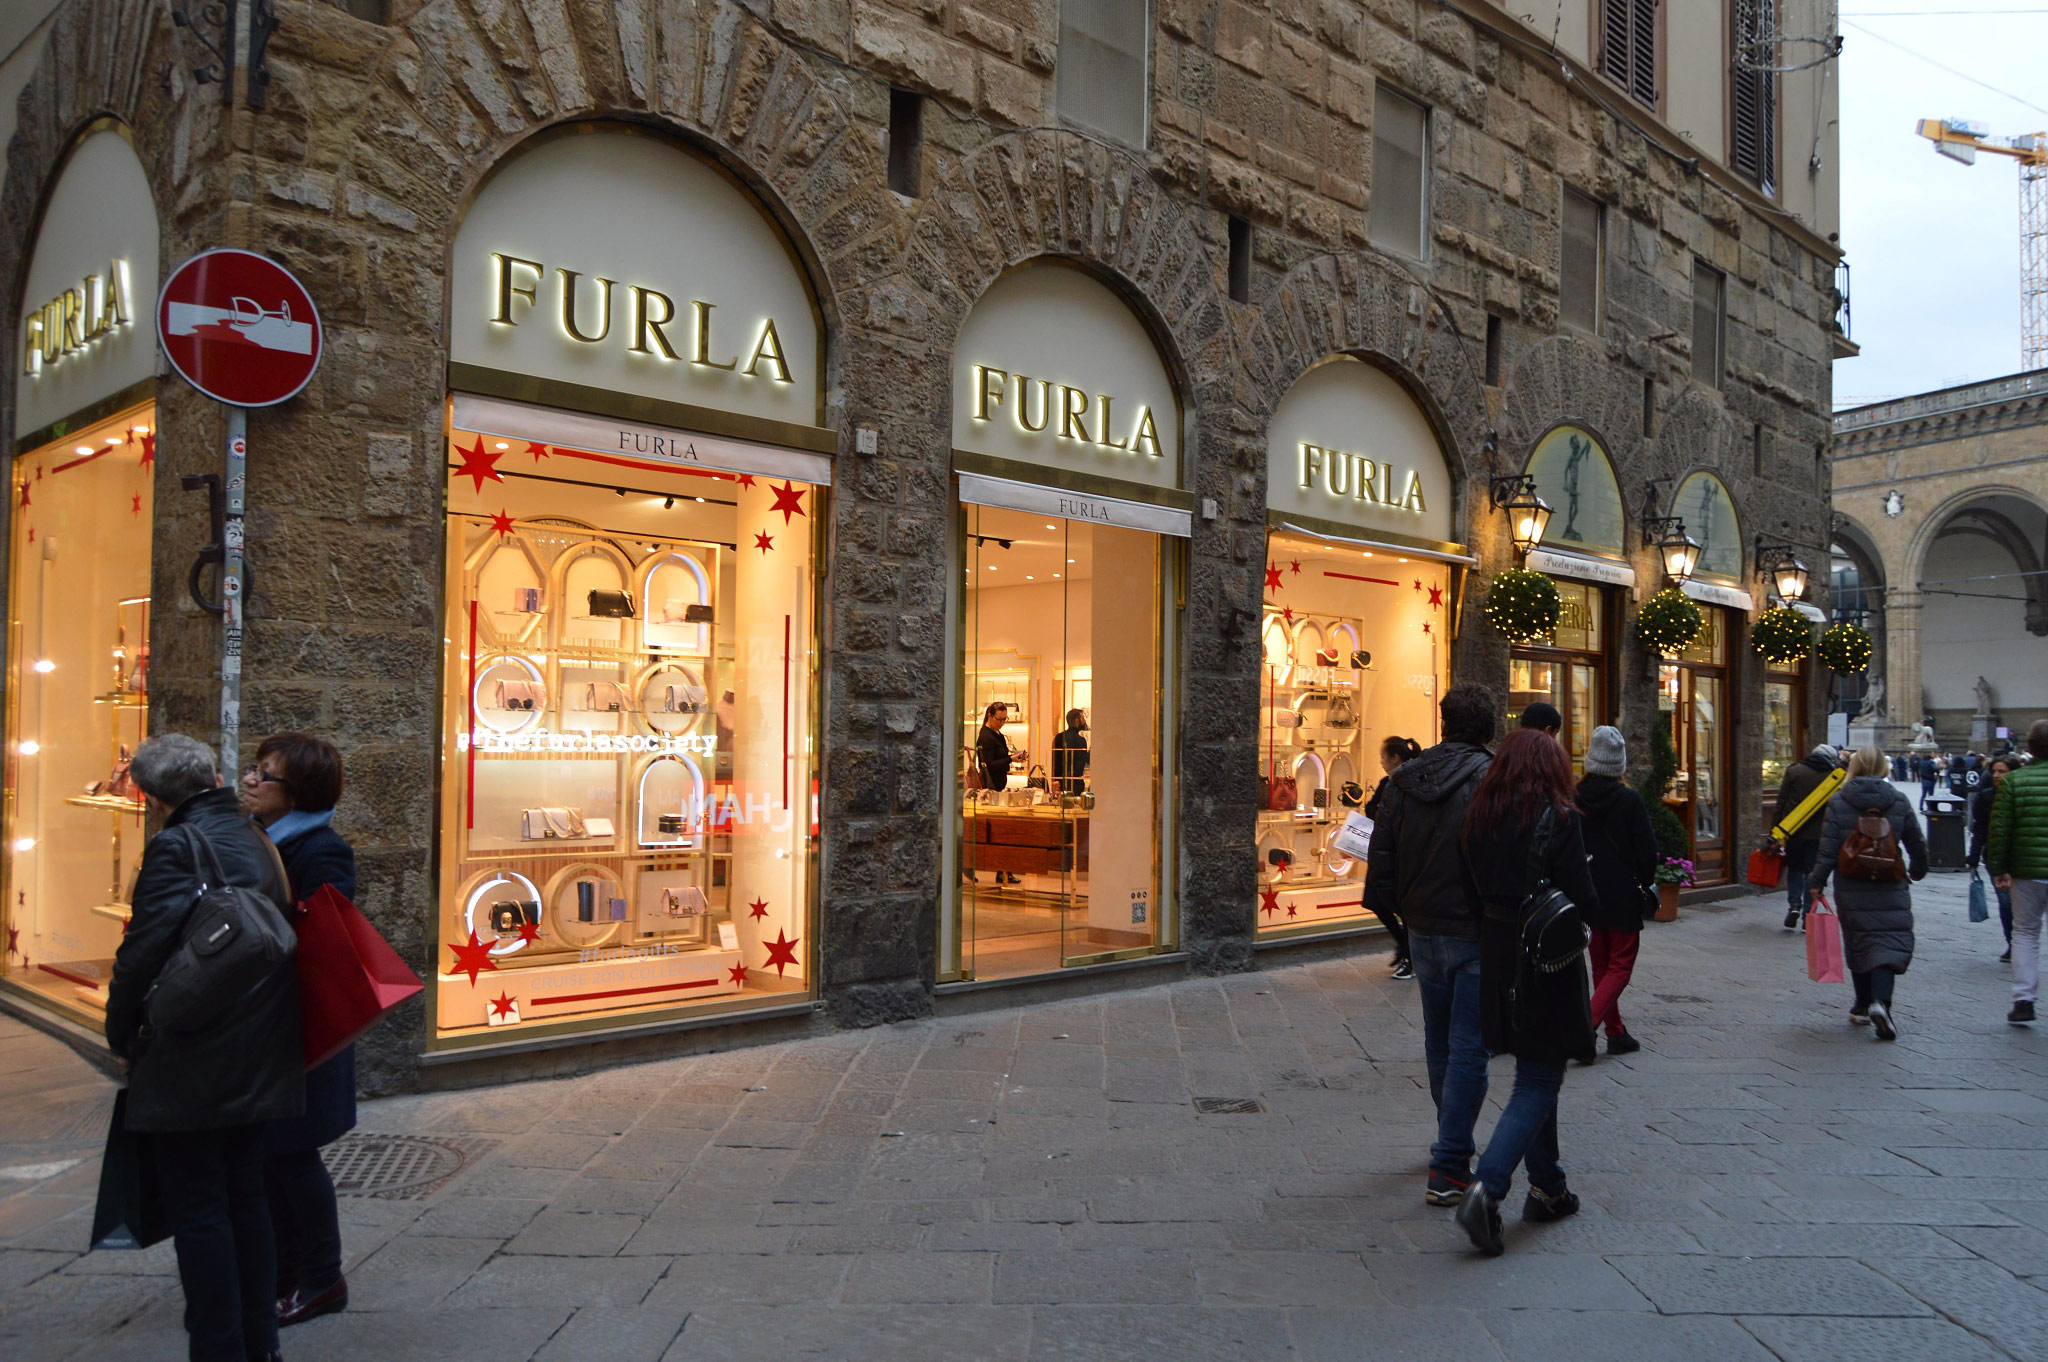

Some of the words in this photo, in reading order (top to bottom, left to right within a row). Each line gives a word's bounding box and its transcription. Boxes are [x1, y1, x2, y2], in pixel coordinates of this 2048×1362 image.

[24, 258, 131, 378] FURLA
[490, 252, 795, 384] FURLA
[973, 364, 1165, 458] FURLA
[618, 431, 699, 461] FURLA
[1298, 442, 1427, 513] FURLA
[1059, 498, 1110, 521] FURLA
[1544, 555, 1590, 575] Produzione
[1592, 562, 1622, 581] Propria
[1347, 824, 1371, 840] TEZE
[578, 943, 680, 964] #furlagifts
[530, 971, 588, 991] CRUISE
[592, 968, 625, 985] 2019
[629, 960, 722, 981] COLLECTION
